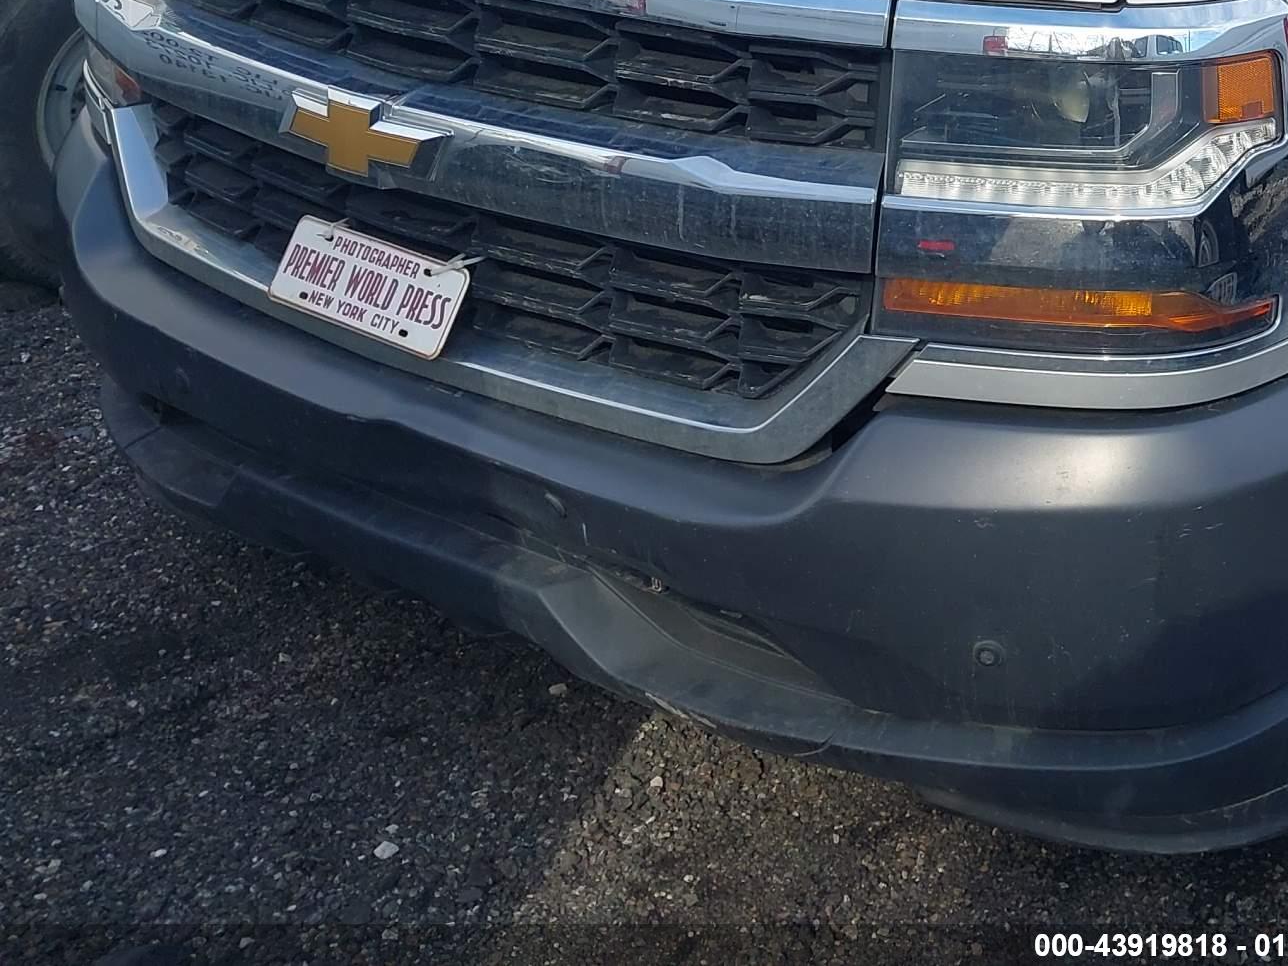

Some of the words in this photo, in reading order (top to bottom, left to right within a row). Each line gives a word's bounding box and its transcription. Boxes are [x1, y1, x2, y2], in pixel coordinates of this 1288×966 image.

[332, 236, 421, 279] PHOTOGRAPHER
[283, 244, 345, 292] PREMIER
[344, 264, 399, 311] WORLD
[397, 284, 452, 330] PRESS
[308, 290, 335, 309] NEW
[336, 300, 368, 323] YORK
[370, 313, 400, 335] CITY
